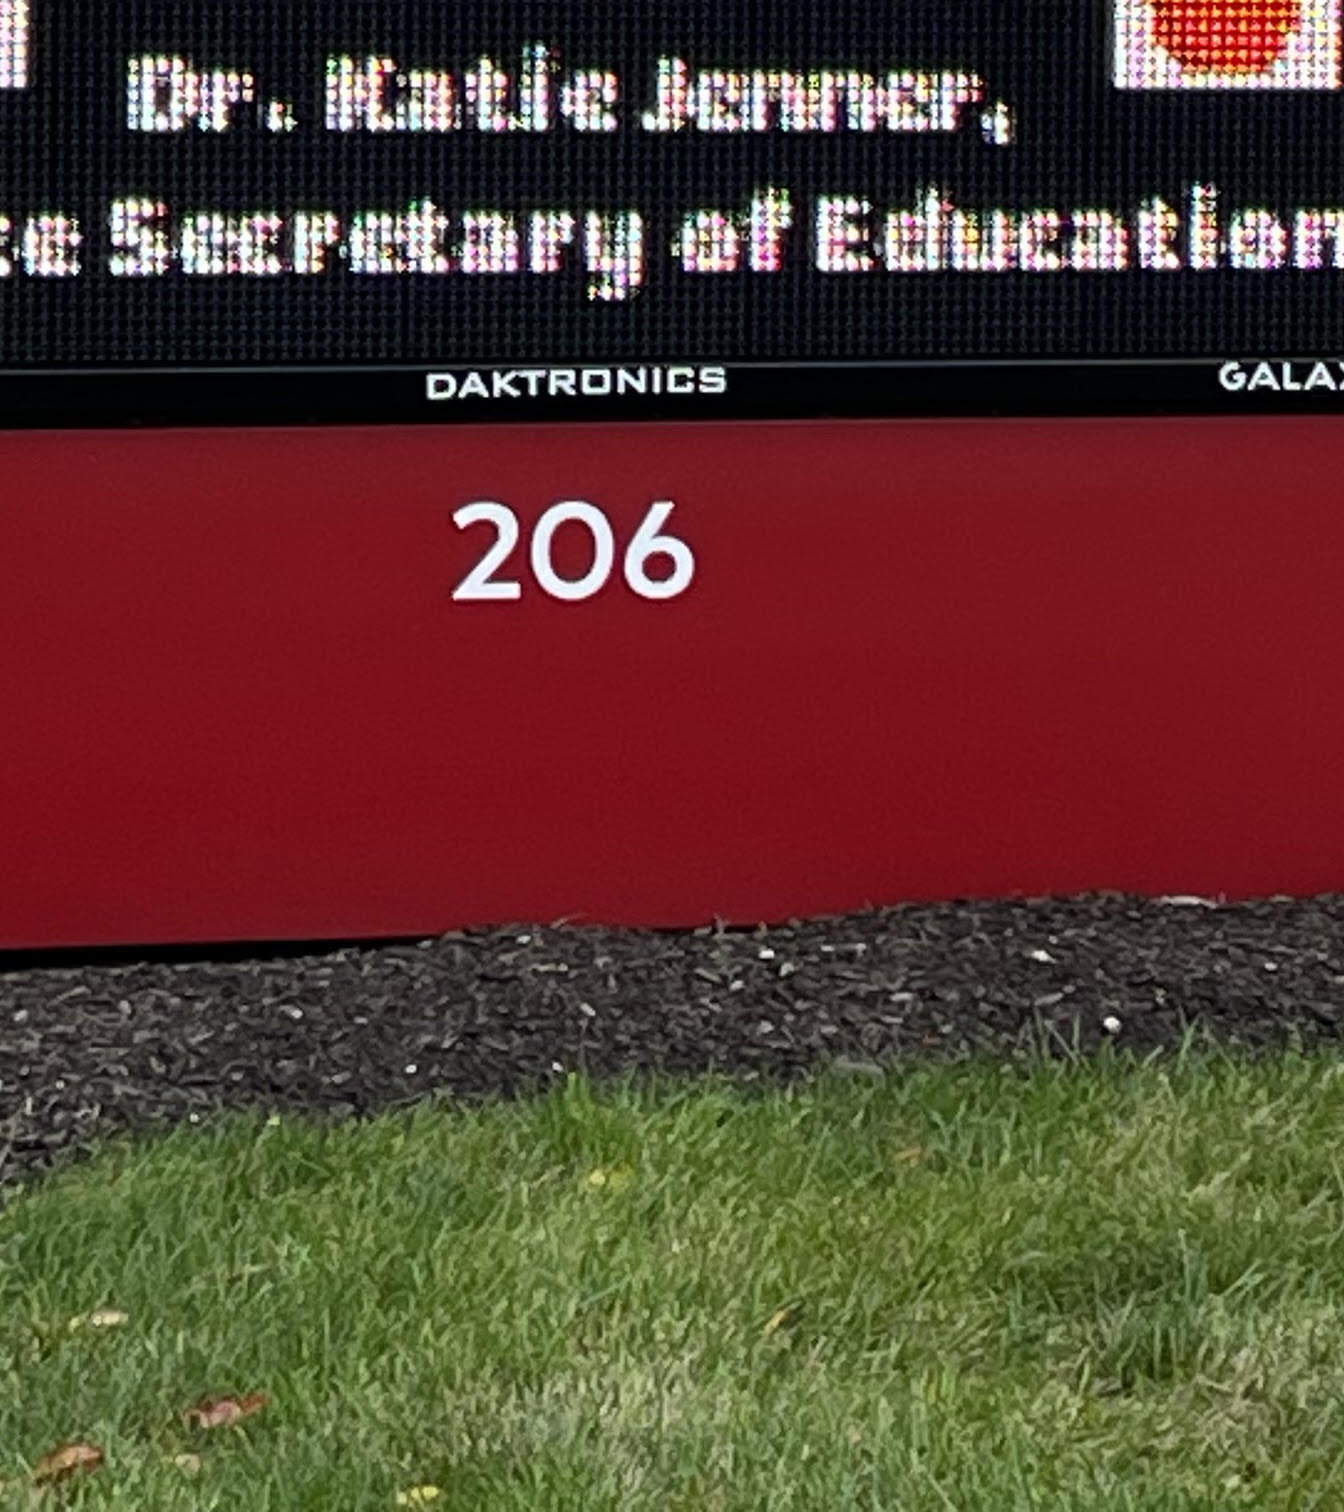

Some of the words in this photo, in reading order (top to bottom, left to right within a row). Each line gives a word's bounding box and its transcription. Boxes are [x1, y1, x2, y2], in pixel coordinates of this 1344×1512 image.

[127, 55, 297, 132] Dr.
[326, 45, 617, 132] Katie
[642, 56, 1009, 144] Jenner,
[109, 197, 642, 300] Secretary
[672, 187, 791, 272] of
[425, 366, 728, 400] DAKTRONICS
[453, 501, 693, 600] 206
